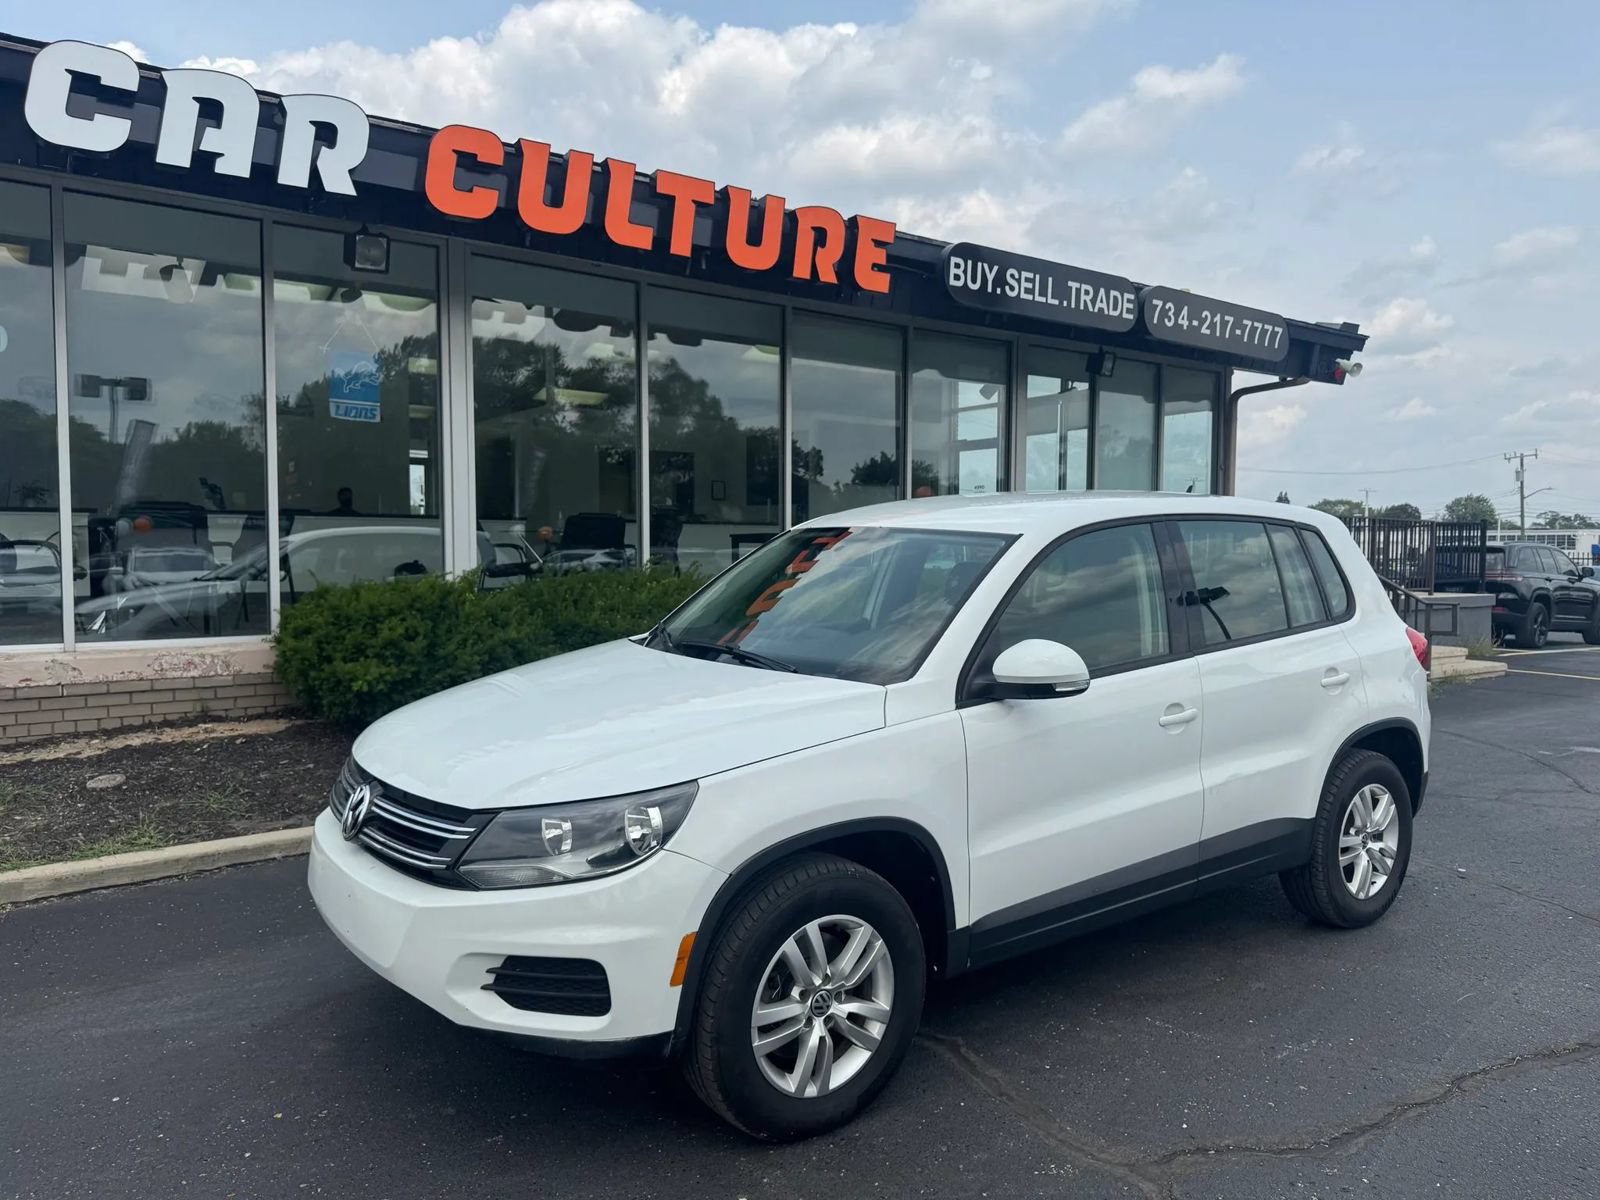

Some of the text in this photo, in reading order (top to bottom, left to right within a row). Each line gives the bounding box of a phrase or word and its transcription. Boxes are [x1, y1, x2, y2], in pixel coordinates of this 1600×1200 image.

[24, 40, 896, 293] CAR CULTURE
[1152, 299, 1283, 350] 734-217-7777
